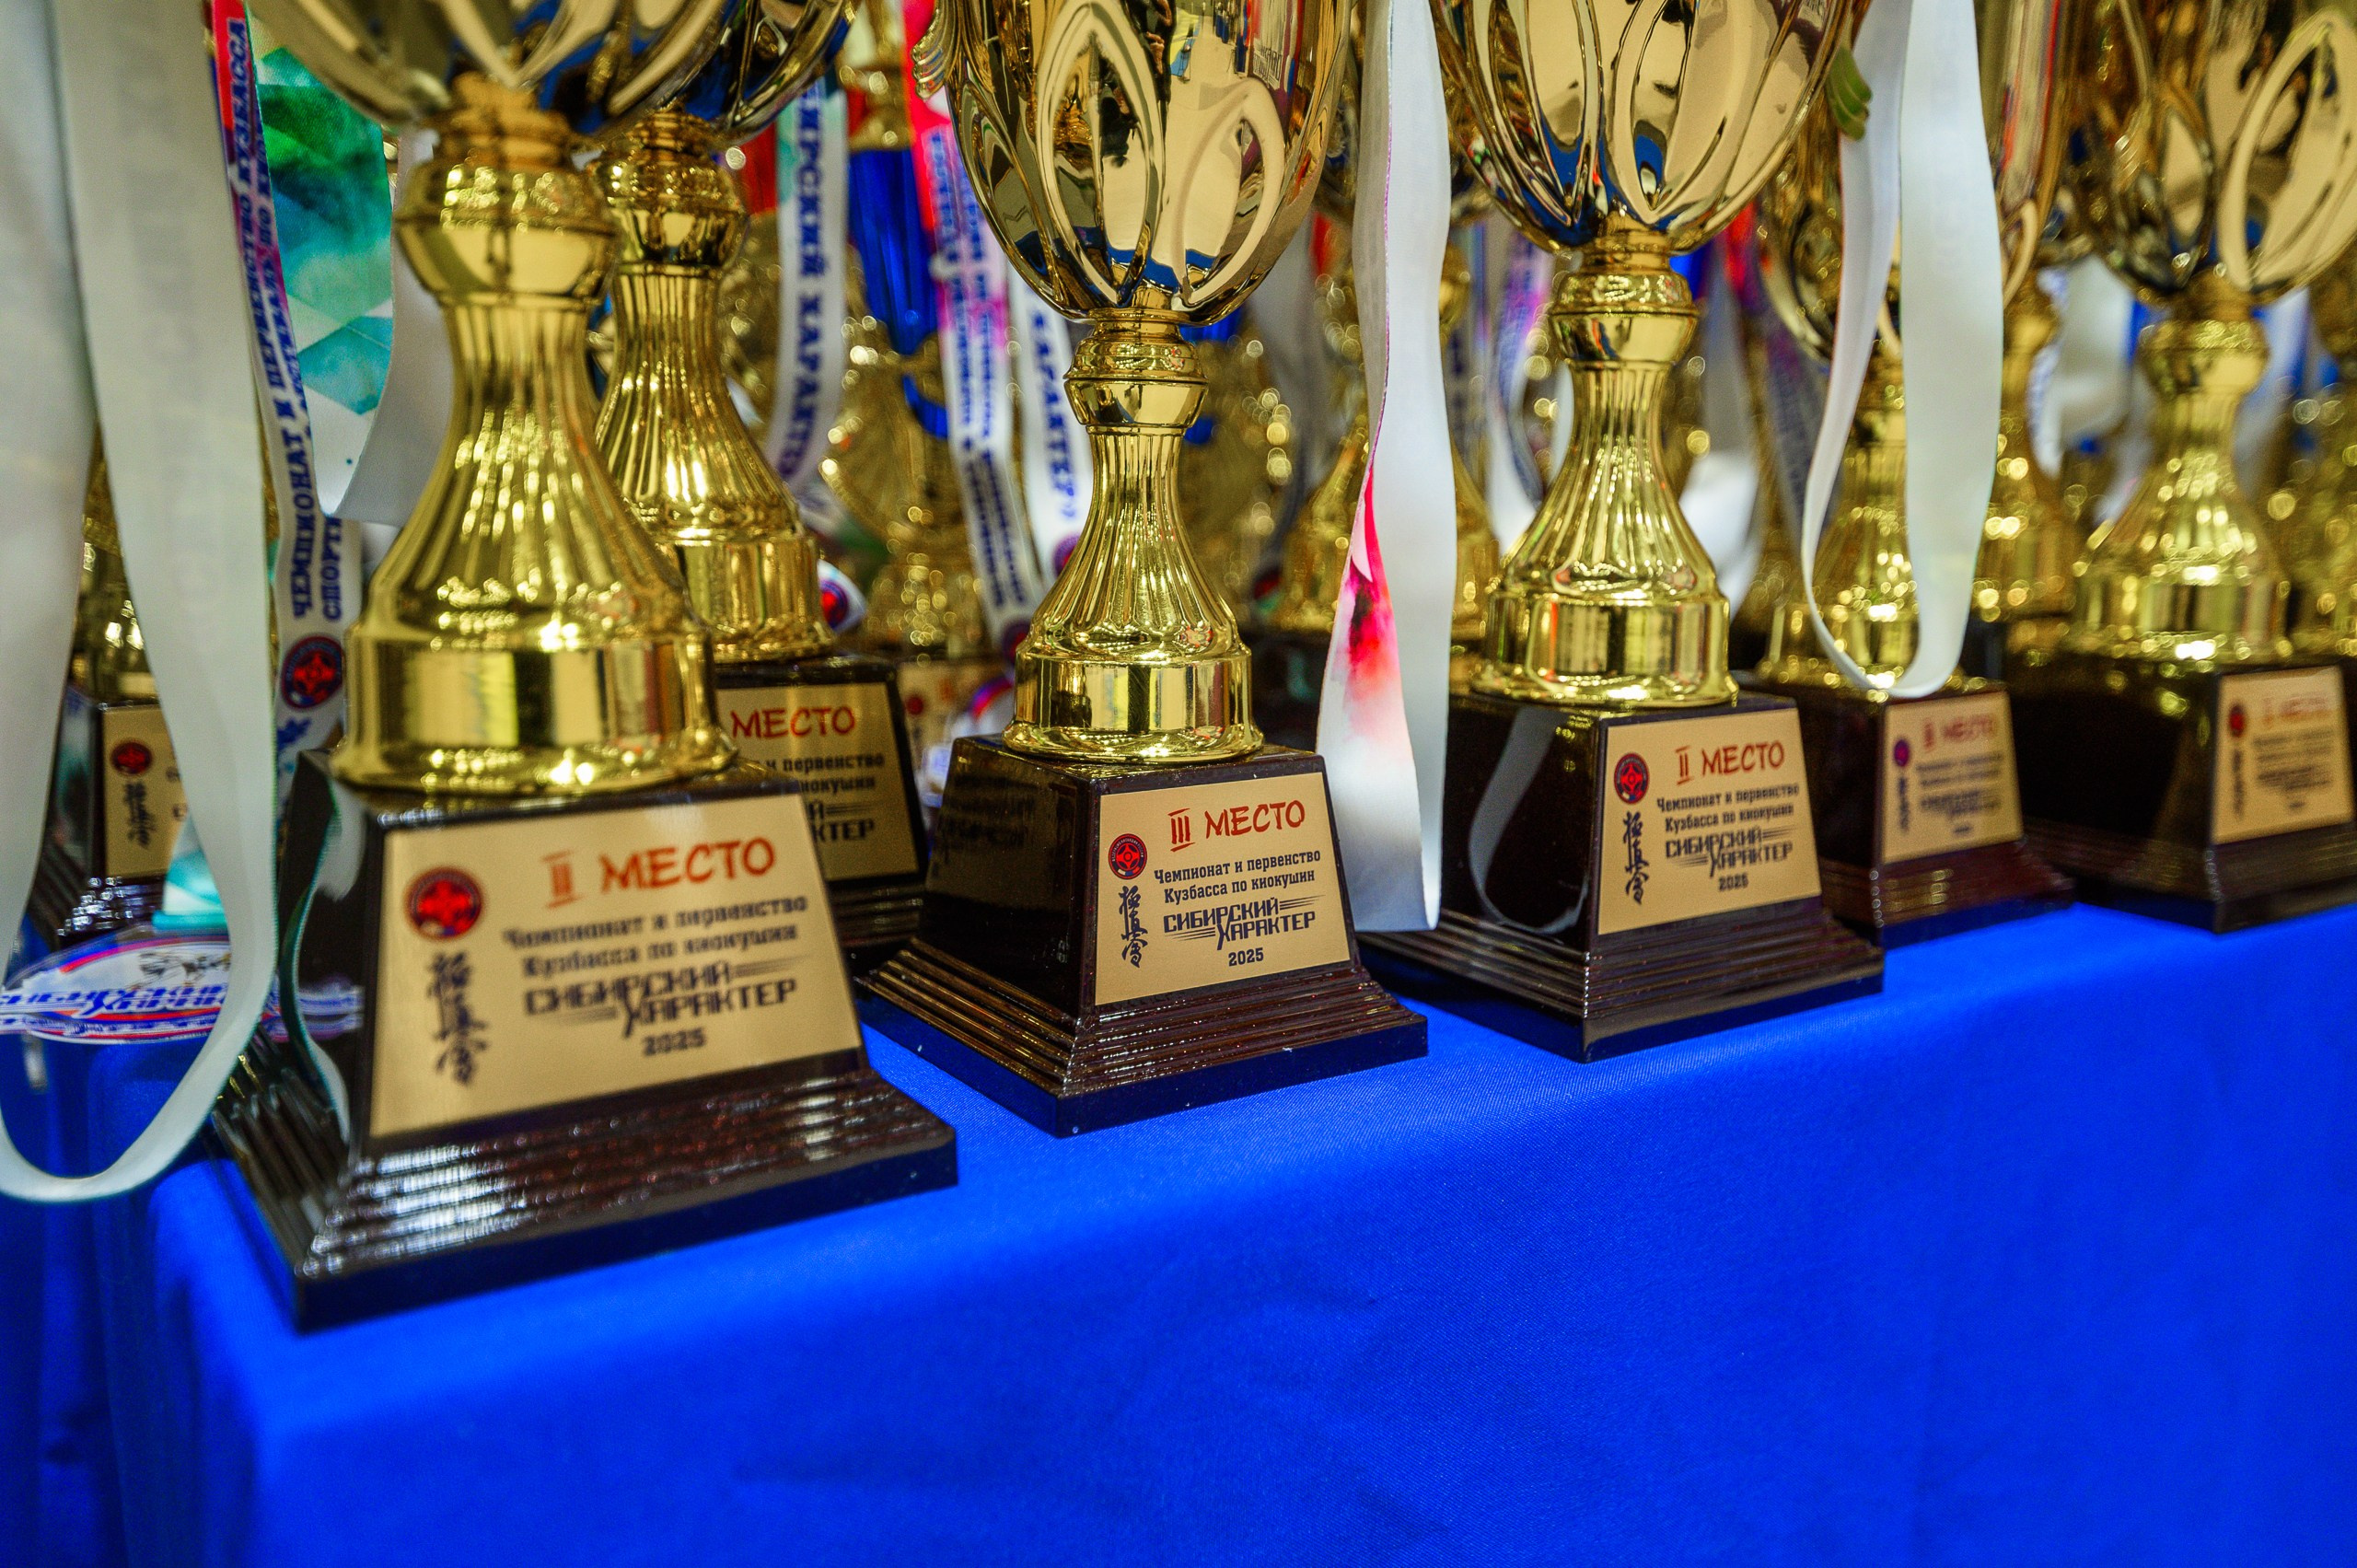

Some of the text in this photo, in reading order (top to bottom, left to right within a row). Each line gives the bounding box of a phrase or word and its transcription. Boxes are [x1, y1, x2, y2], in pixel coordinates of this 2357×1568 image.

[226, 18, 251, 187] КУЗБАССА
[273, 398, 296, 420] И
[281, 426, 316, 621] ЧЕМПИОНАТ
[730, 704, 856, 739] МЕСТО
[783, 753, 885, 775] первенство
[1676, 745, 1695, 786] II
[1701, 739, 1785, 776] МЕСТО
[800, 776, 876, 796] иокушин
[1656, 792, 1723, 813] Чемпионат
[1736, 783, 1800, 803] первенство
[1167, 807, 1196, 853] III
[1204, 800, 1306, 839] МЕСТО
[1665, 804, 1794, 834] Кузбасса по киокушин
[1665, 825, 1763, 859] СИБИРСКИЙ
[599, 837, 775, 895] МЕСТО
[1154, 850, 1321, 885] Чемпионат и первенство
[1710, 841, 1794, 879] ХАРАКТЕР
[1164, 870, 1316, 906] Кузбасса по киокушин
[1718, 872, 1749, 892] 2025
[1163, 897, 1280, 934] СИБИРСКИЙ
[1216, 911, 1317, 951] ХАРАКТЕР
[1227, 947, 1264, 967] 2025
[524, 959, 732, 1016] СИБИРСКИЙ
[622, 977, 798, 1040] ХАРАКТЕР
[642, 1027, 707, 1057] 2025
